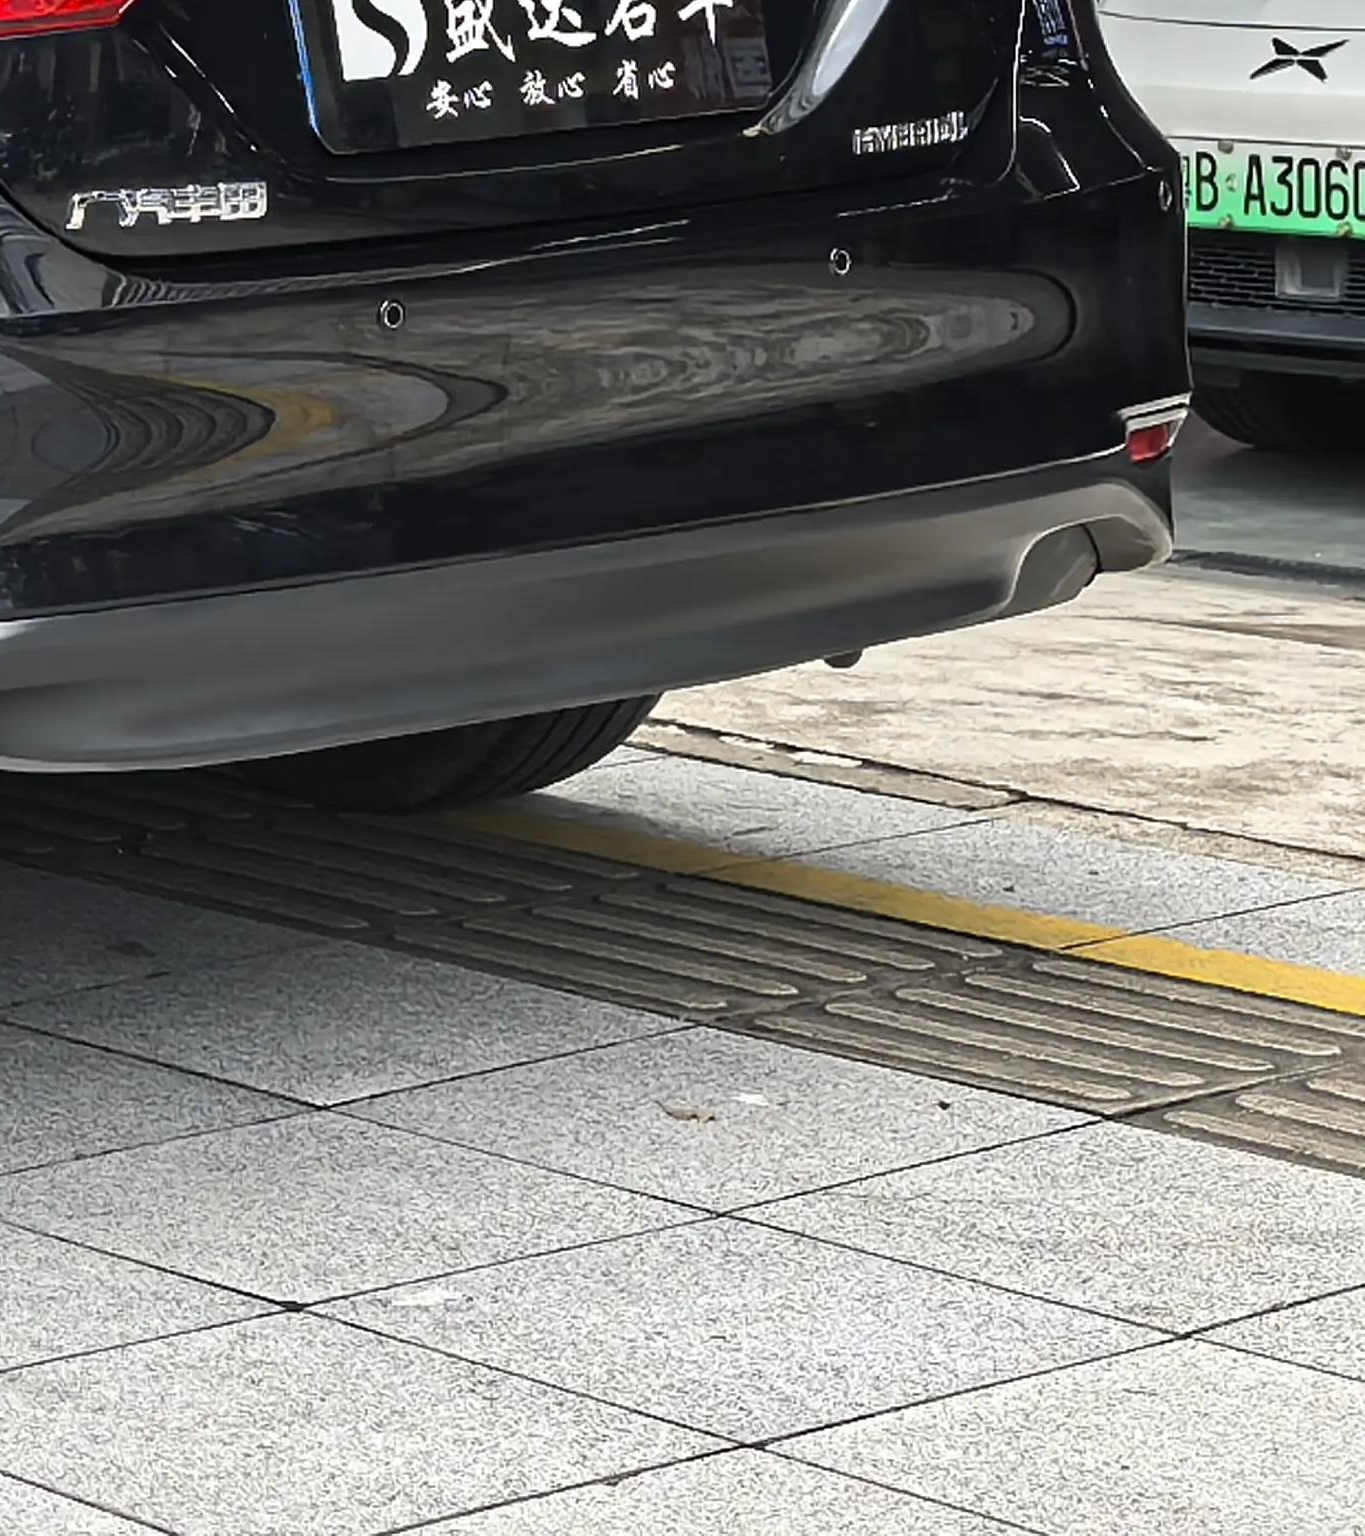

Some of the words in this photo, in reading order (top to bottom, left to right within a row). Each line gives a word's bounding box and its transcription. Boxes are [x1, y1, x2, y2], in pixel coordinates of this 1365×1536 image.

[425, 79, 494, 120] 安心
[519, 70, 587, 107] 放心
[612, 61, 677, 101] 省心
